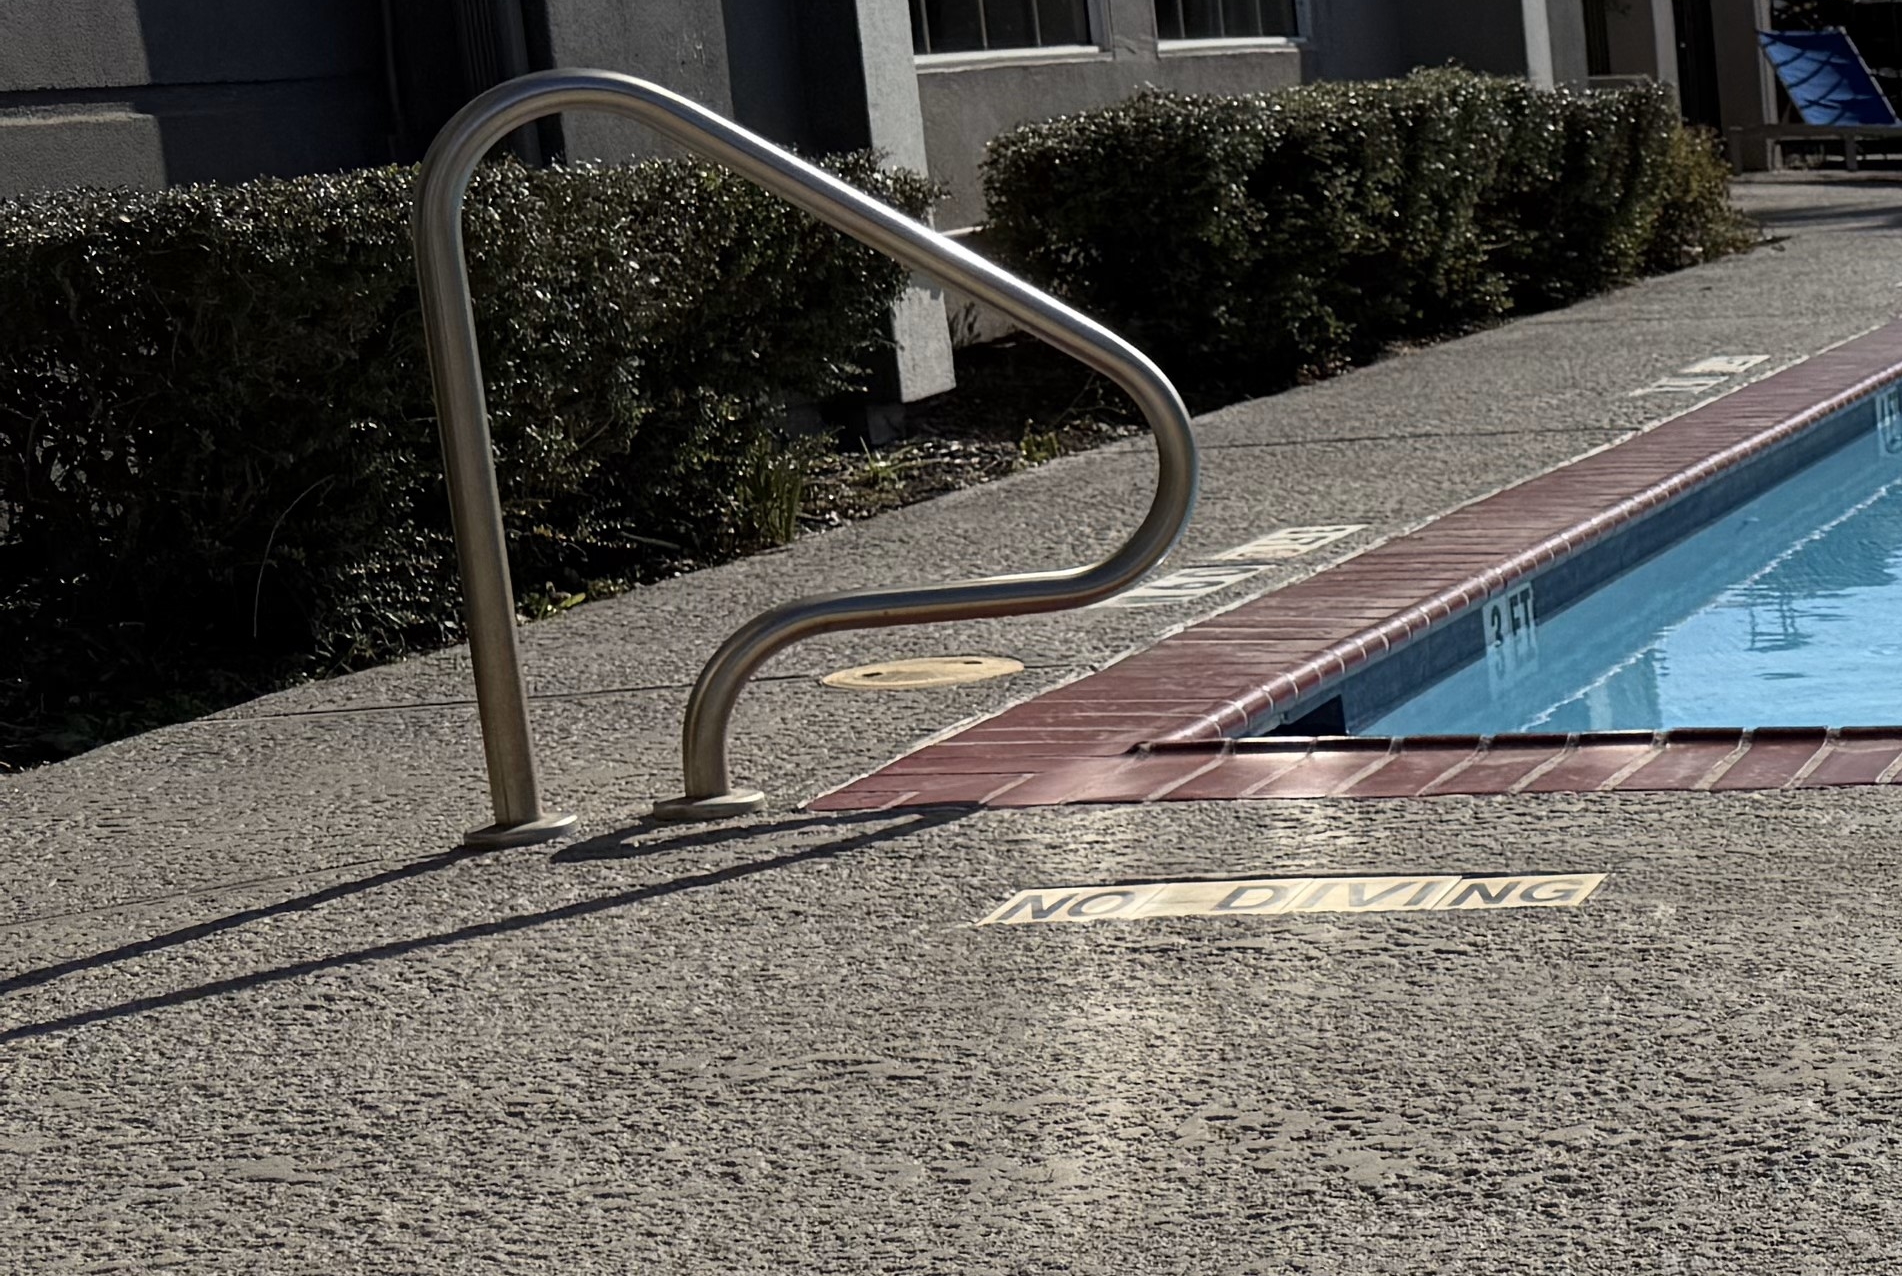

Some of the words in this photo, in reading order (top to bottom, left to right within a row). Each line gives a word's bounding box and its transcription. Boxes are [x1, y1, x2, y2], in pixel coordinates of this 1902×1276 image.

[1509, 587, 1532, 637] FT
[1000, 890, 1138, 921] NO
[1211, 880, 1585, 911] DIVING
